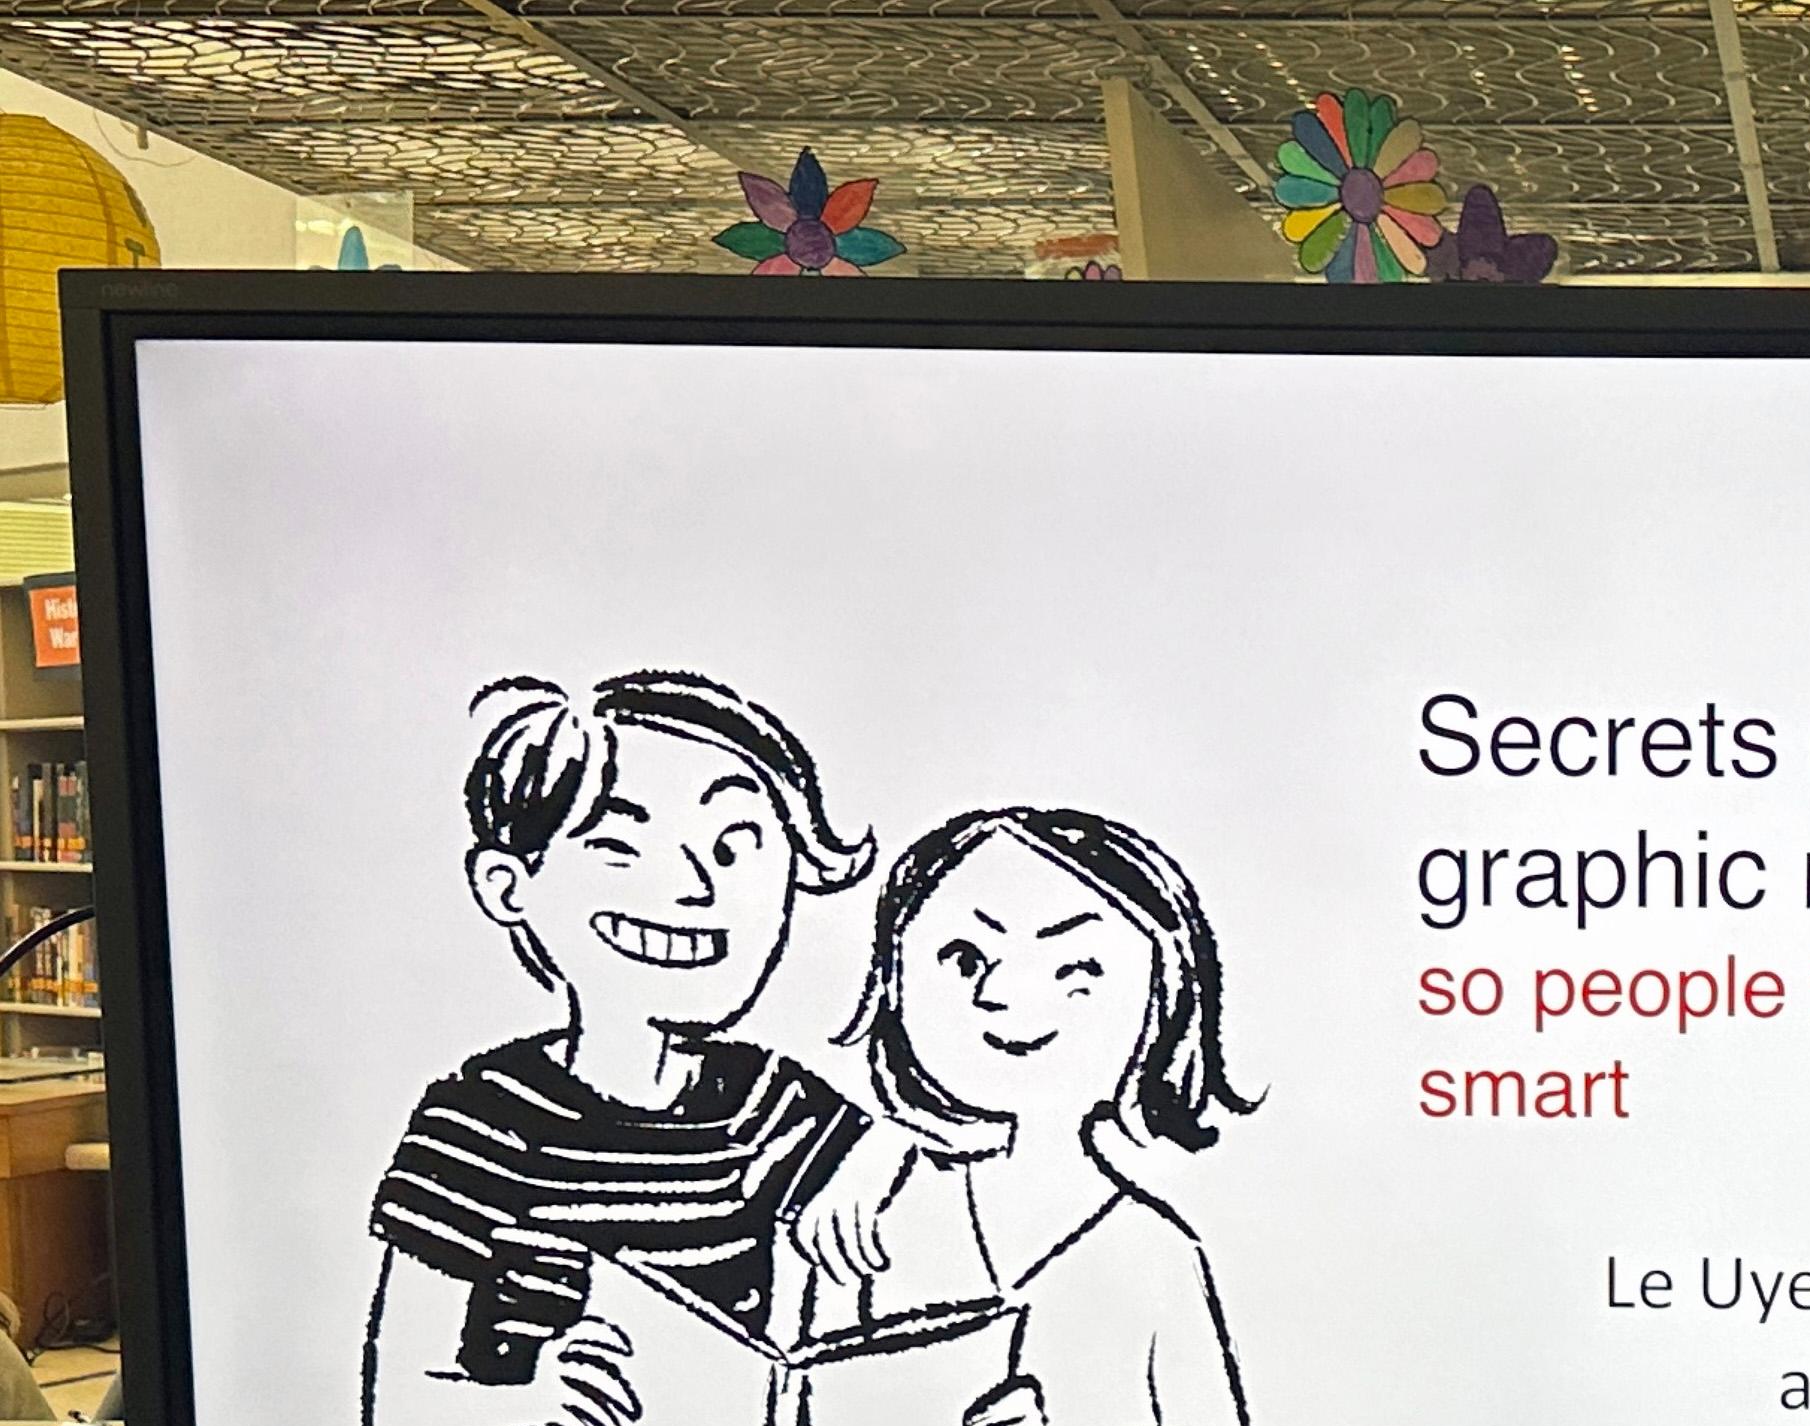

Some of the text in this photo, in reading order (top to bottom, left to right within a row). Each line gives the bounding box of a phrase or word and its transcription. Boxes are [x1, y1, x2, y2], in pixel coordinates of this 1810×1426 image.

[1419, 693, 1777, 779] Secrets
[1418, 829, 1766, 930] graphic
[1419, 967, 1504, 1016] so
[1535, 954, 1786, 1034] people
[1420, 1059, 1630, 1119] smart
[1608, 1256, 1673, 1309] Le
